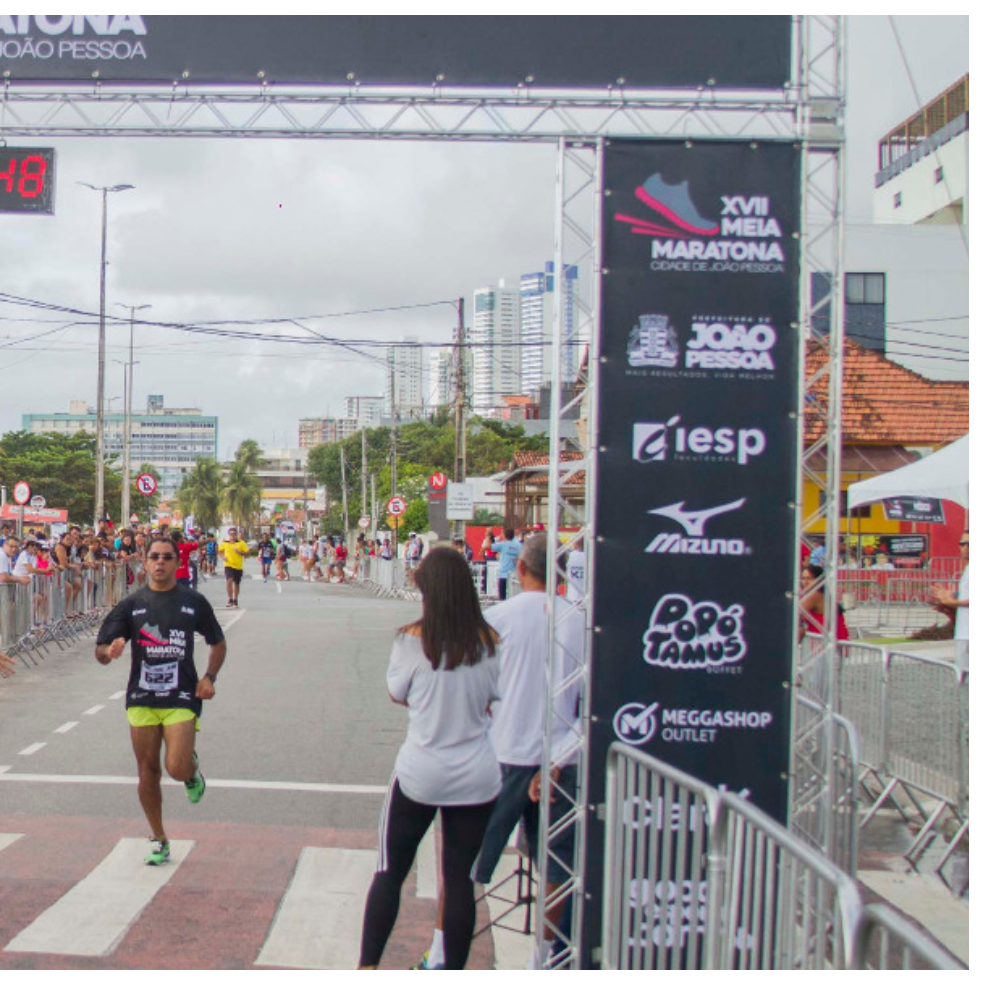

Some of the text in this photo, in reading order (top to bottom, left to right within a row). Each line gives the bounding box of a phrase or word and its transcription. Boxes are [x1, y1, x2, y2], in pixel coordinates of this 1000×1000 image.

[58, 41, 147, 60] PESSOA
[720, 196, 769, 216] XVII
[721, 217, 781, 237] MEIA
[651, 239, 785, 262] MARATONA
[650, 260, 690, 271] CIDADE
[692, 261, 708, 272] DE
[740, 262, 785, 273] PESSOA
[687, 322, 777, 351] JOÃO
[685, 350, 775, 370] PESSOA
[676, 426, 766, 465] iesp
[645, 533, 745, 555] MIZUNO
[643, 633, 746, 668] TAMUS
[662, 709, 773, 728] MEGGASHOP
[662, 728, 717, 742] OUTLET
